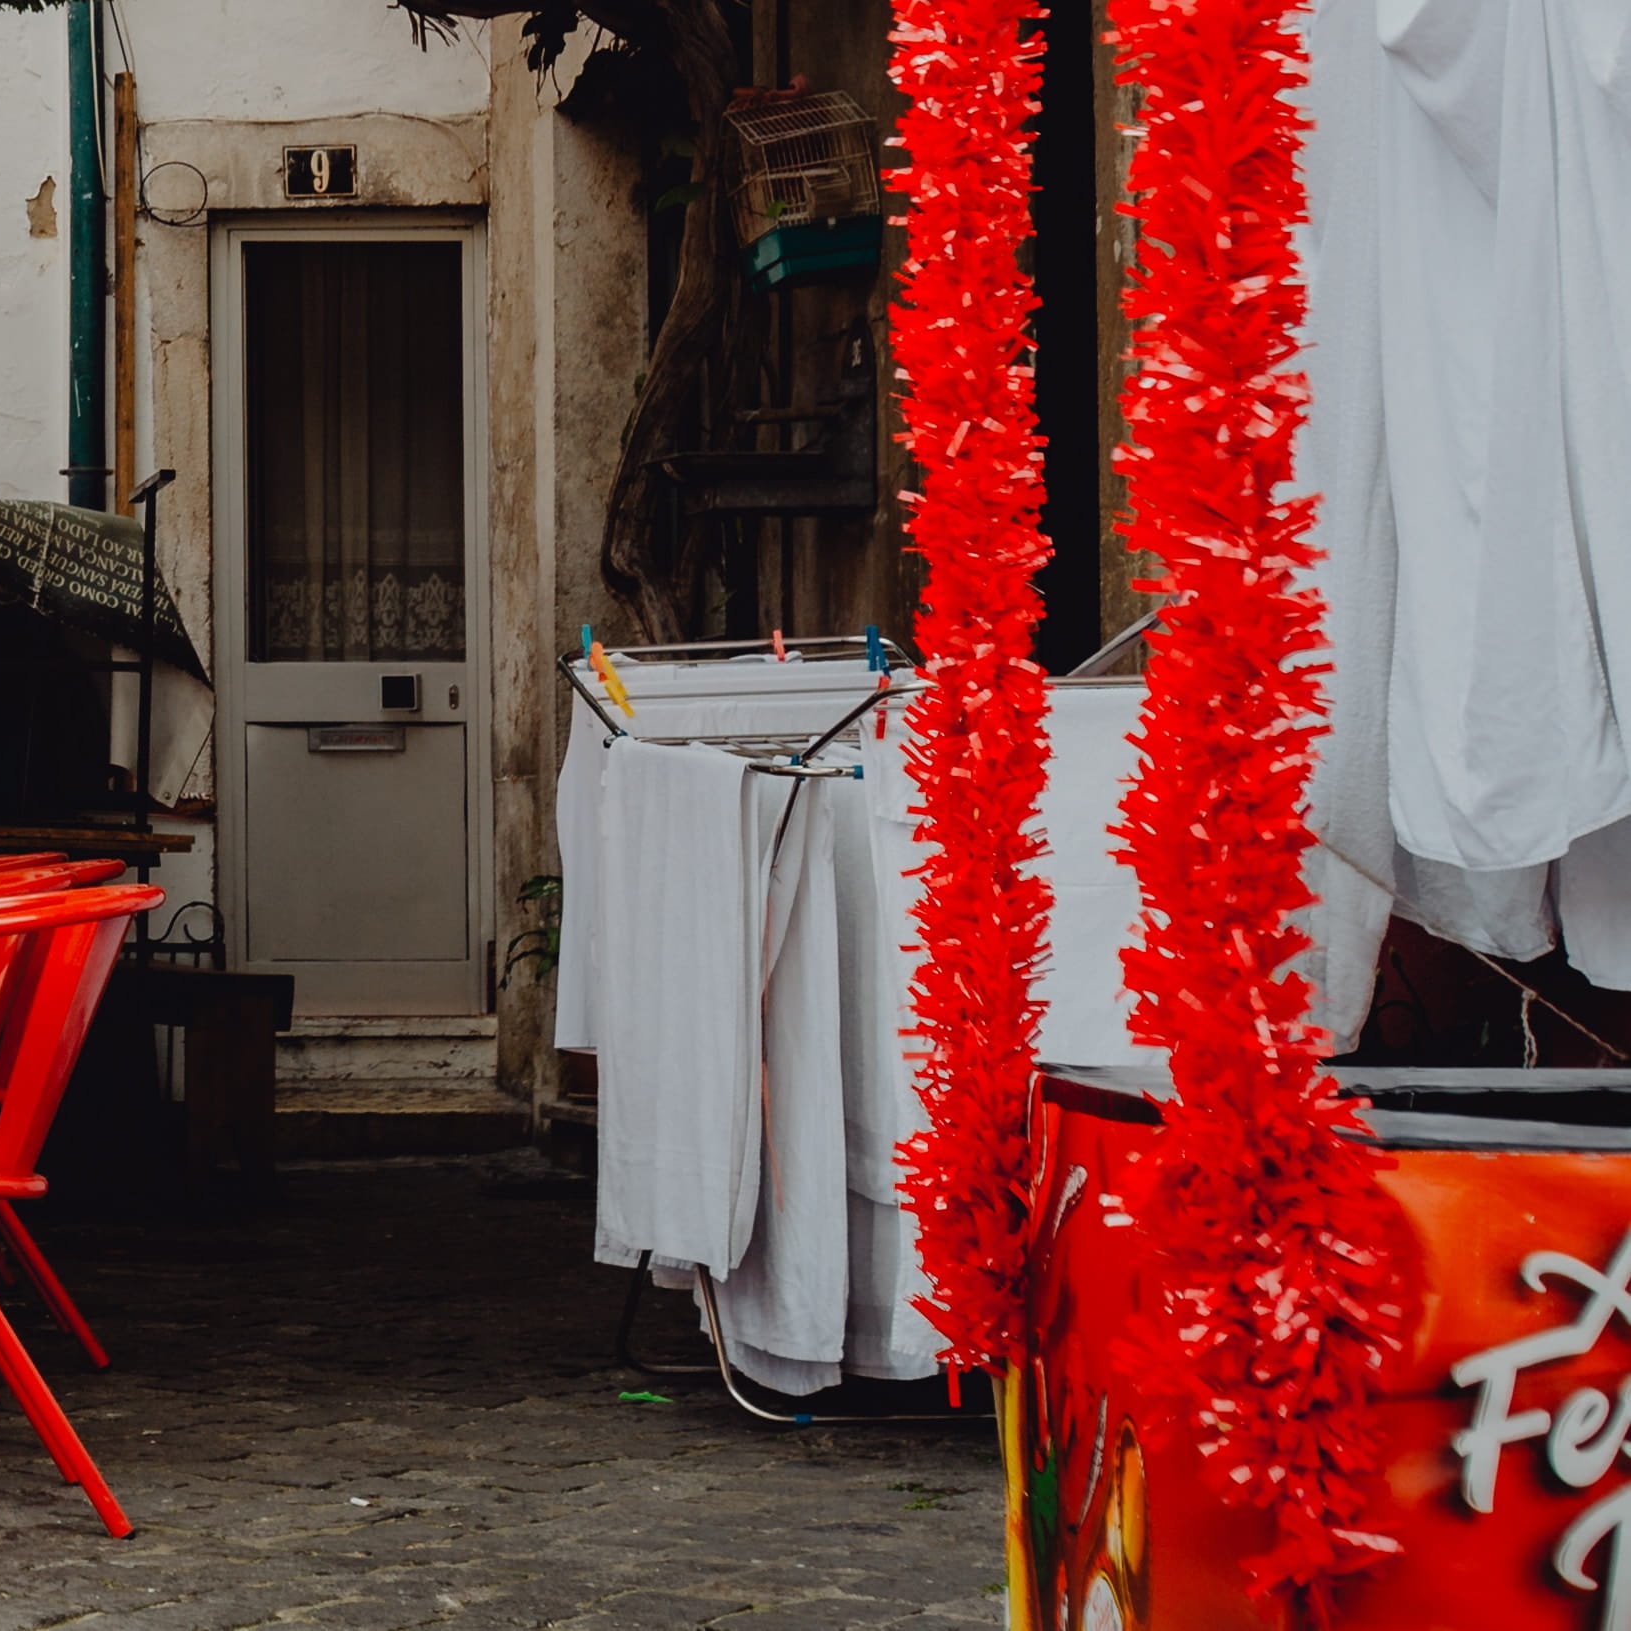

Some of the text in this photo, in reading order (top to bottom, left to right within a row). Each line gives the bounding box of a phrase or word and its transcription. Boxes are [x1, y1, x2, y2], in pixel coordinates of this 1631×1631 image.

[310, 150, 330, 193] 9
[57, 518, 100, 548] LADO
[101, 538, 125, 556] AO
[47, 552, 109, 587] SANGUE
[69, 581, 119, 609] COMO
[123, 599, 144, 620] AL
[1451, 1326, 1631, 1514] Fe
